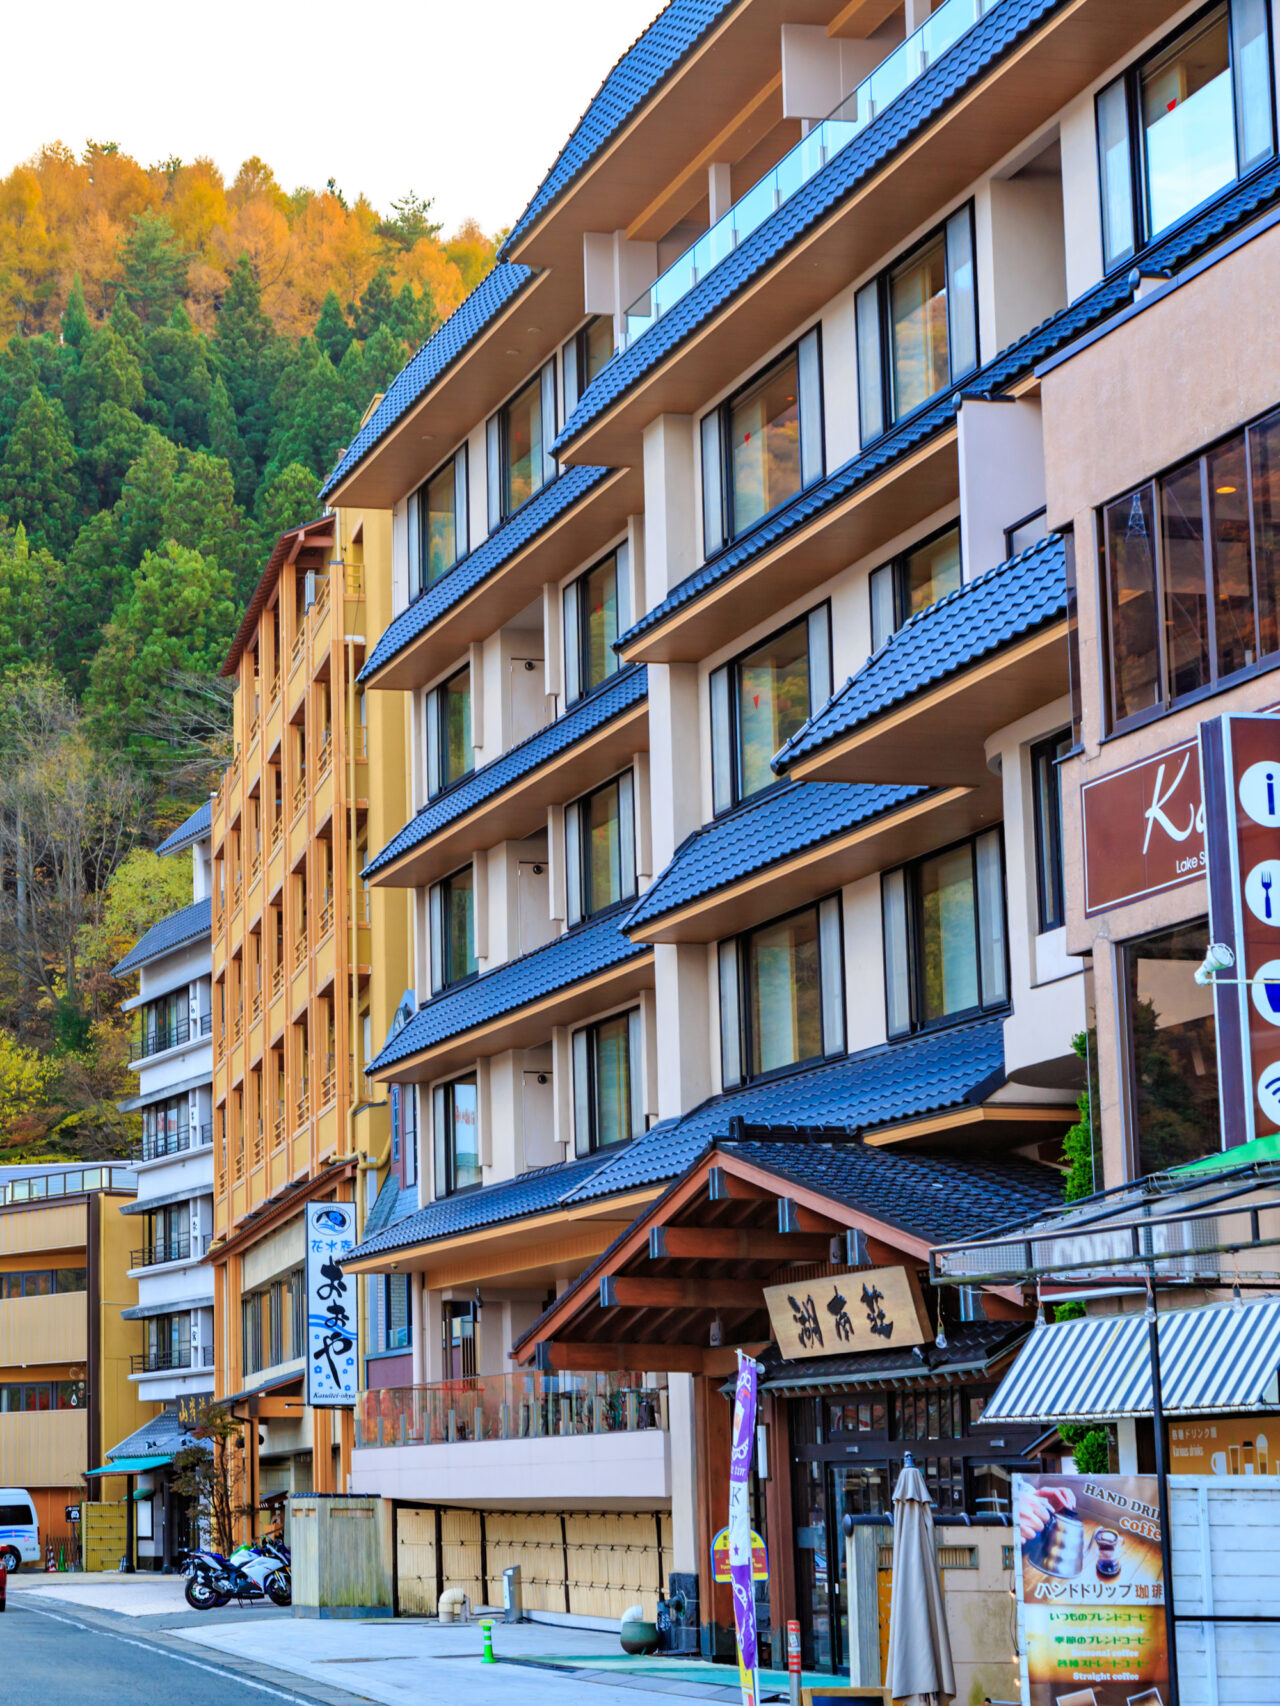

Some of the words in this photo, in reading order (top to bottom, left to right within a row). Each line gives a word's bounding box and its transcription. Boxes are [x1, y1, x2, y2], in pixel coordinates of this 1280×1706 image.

[1142, 751, 1206, 855] K
[1176, 856, 1198, 874] Lake
[1199, 851, 1207, 866] S
[314, 1255, 354, 1389] おおや
[1084, 1483, 1128, 1508] HAND
[1120, 1517, 1162, 1541] coffe
[1036, 1582, 1133, 1600] ハンドドリップ
[1135, 1583, 1163, 1600] 珈琲
[1111, 1648, 1139, 1657] coffee
[1073, 1671, 1111, 1682] Straight
[1112, 1671, 1139, 1681] coffee
